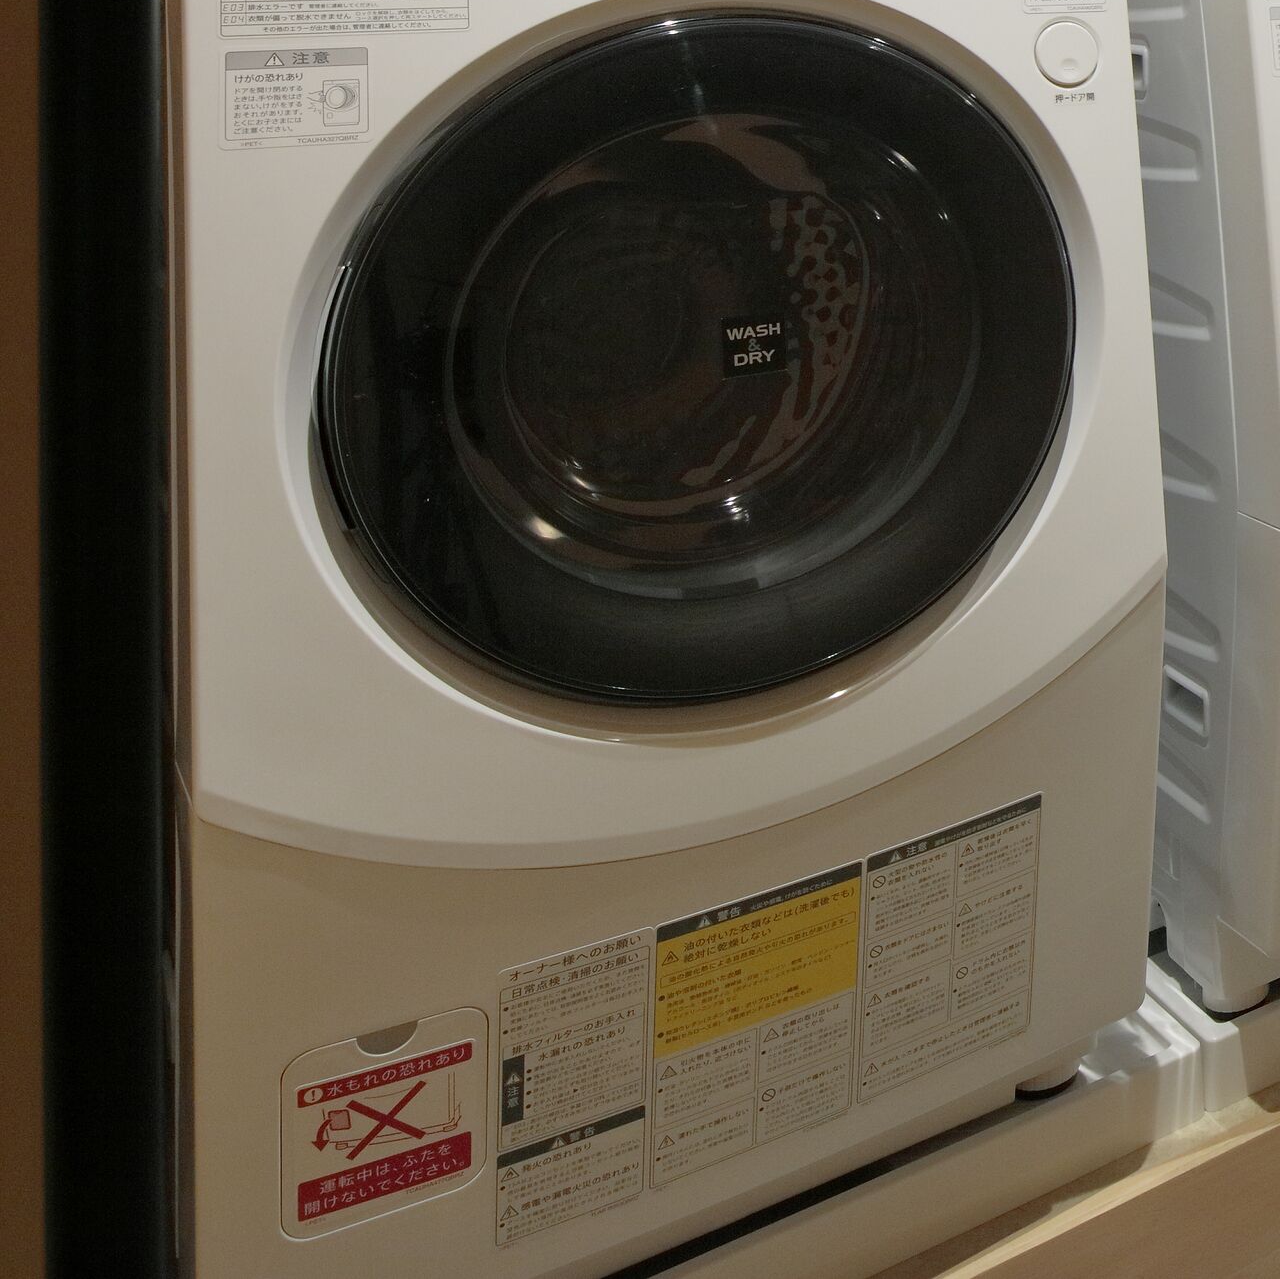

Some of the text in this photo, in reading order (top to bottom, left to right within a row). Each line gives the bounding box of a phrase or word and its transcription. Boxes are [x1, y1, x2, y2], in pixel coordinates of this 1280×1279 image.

[293, 51, 330, 65] 注意
[234, 73, 303, 83] けがの恐れあり
[727, 323, 780, 340] WASH
[748, 338, 760, 351] &
[734, 349, 775, 366] DRY
[509, 935, 641, 982] オーナー様へのお願い
[327, 1046, 465, 1097] 水もれの恐れあり
